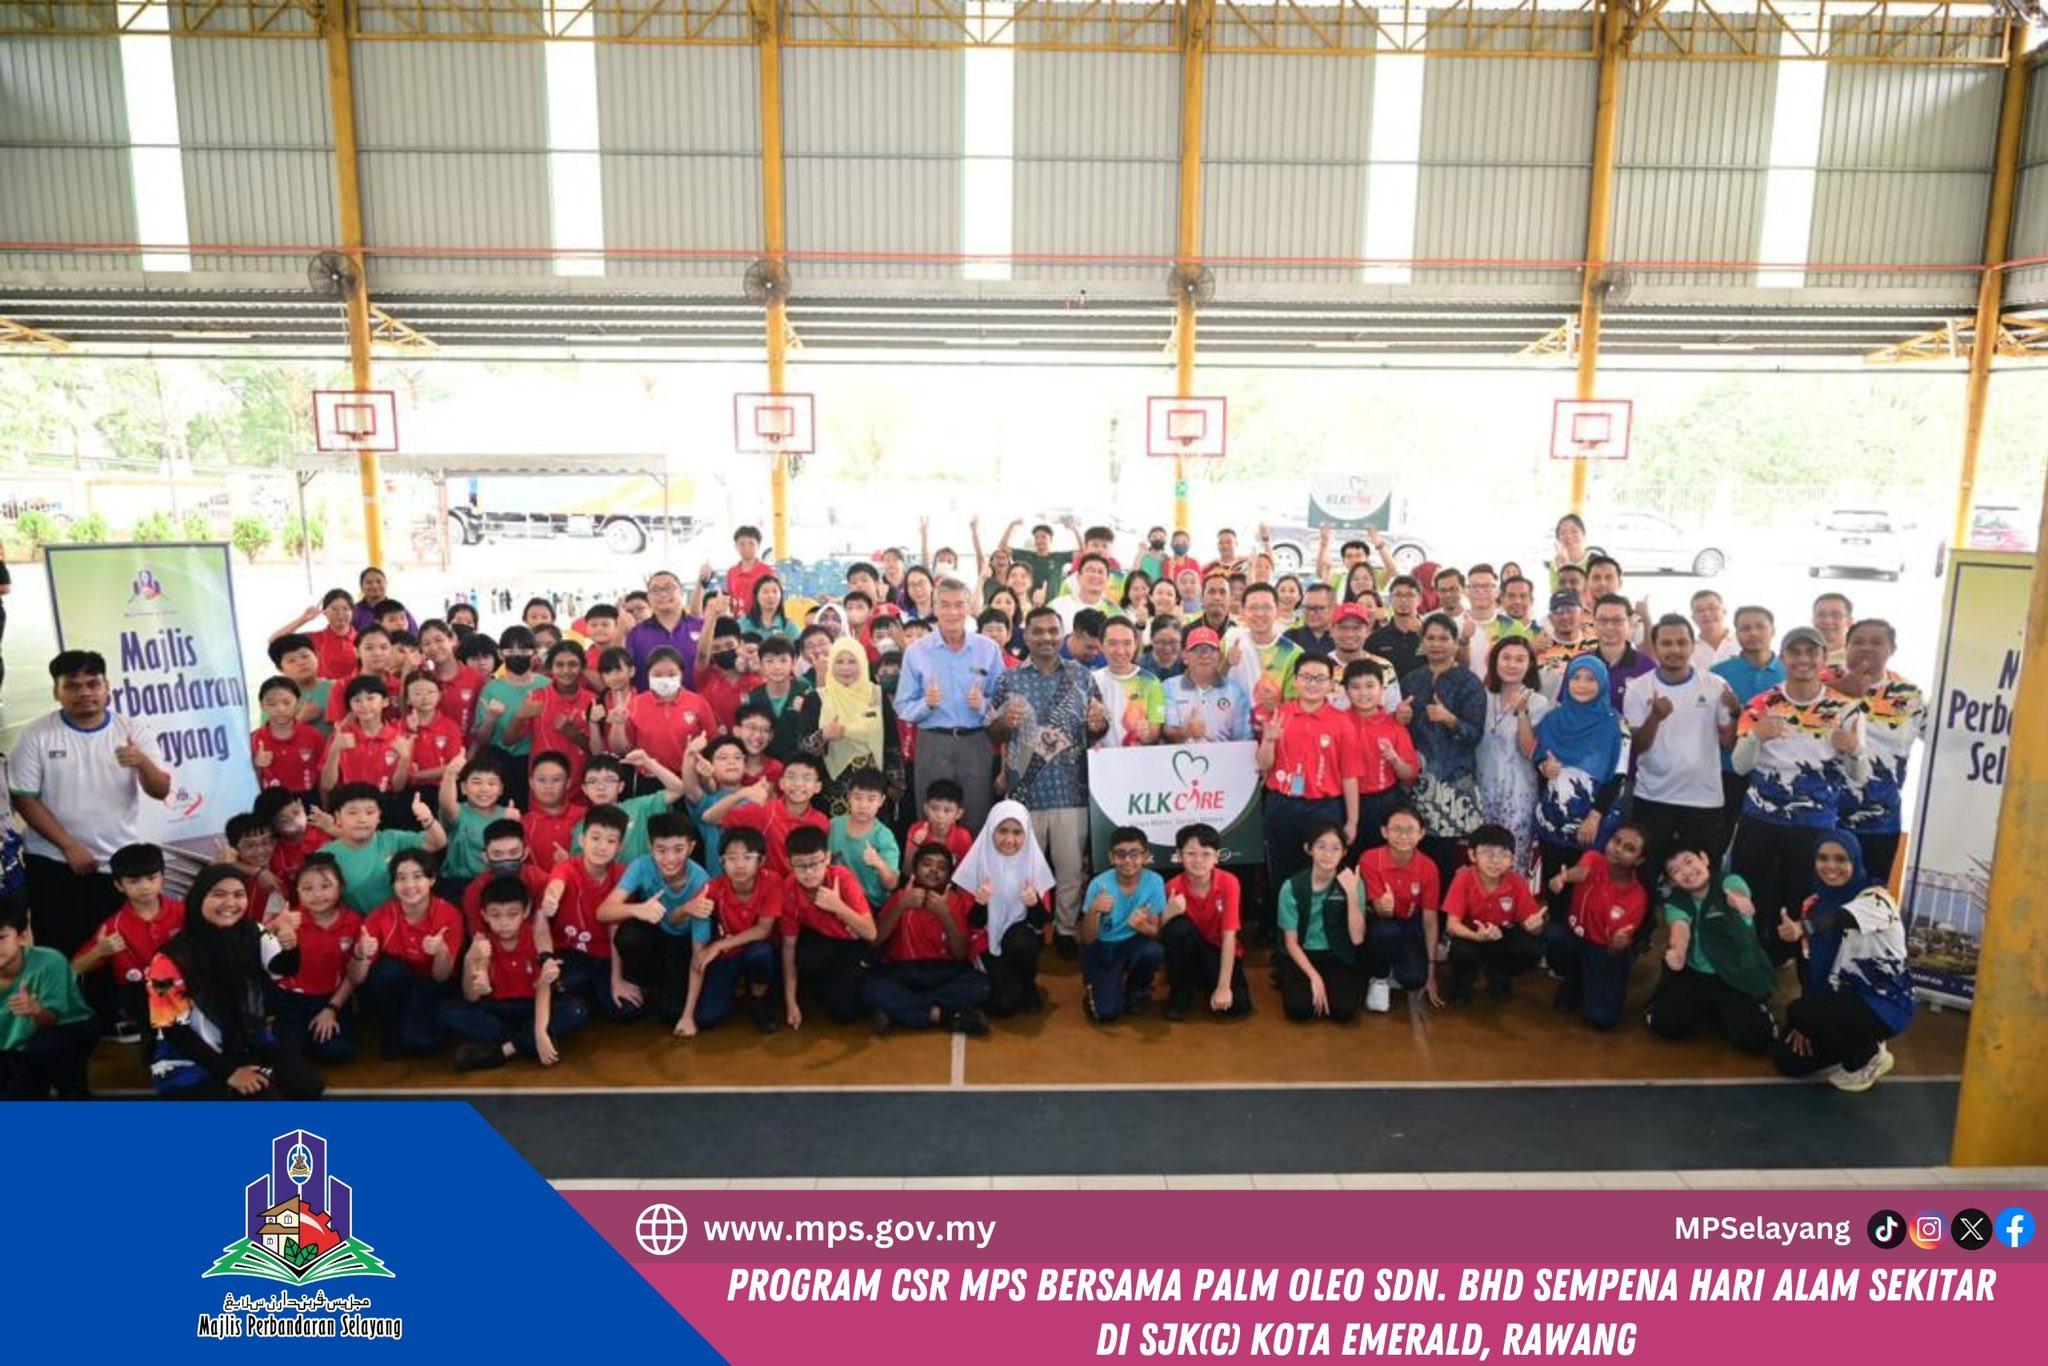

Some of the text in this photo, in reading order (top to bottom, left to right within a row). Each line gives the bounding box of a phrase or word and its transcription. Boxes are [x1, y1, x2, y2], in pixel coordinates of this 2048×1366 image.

[120, 628, 198, 674] Majlis
[112, 672, 243, 718] rbandaran
[156, 724, 229, 768] ayang
